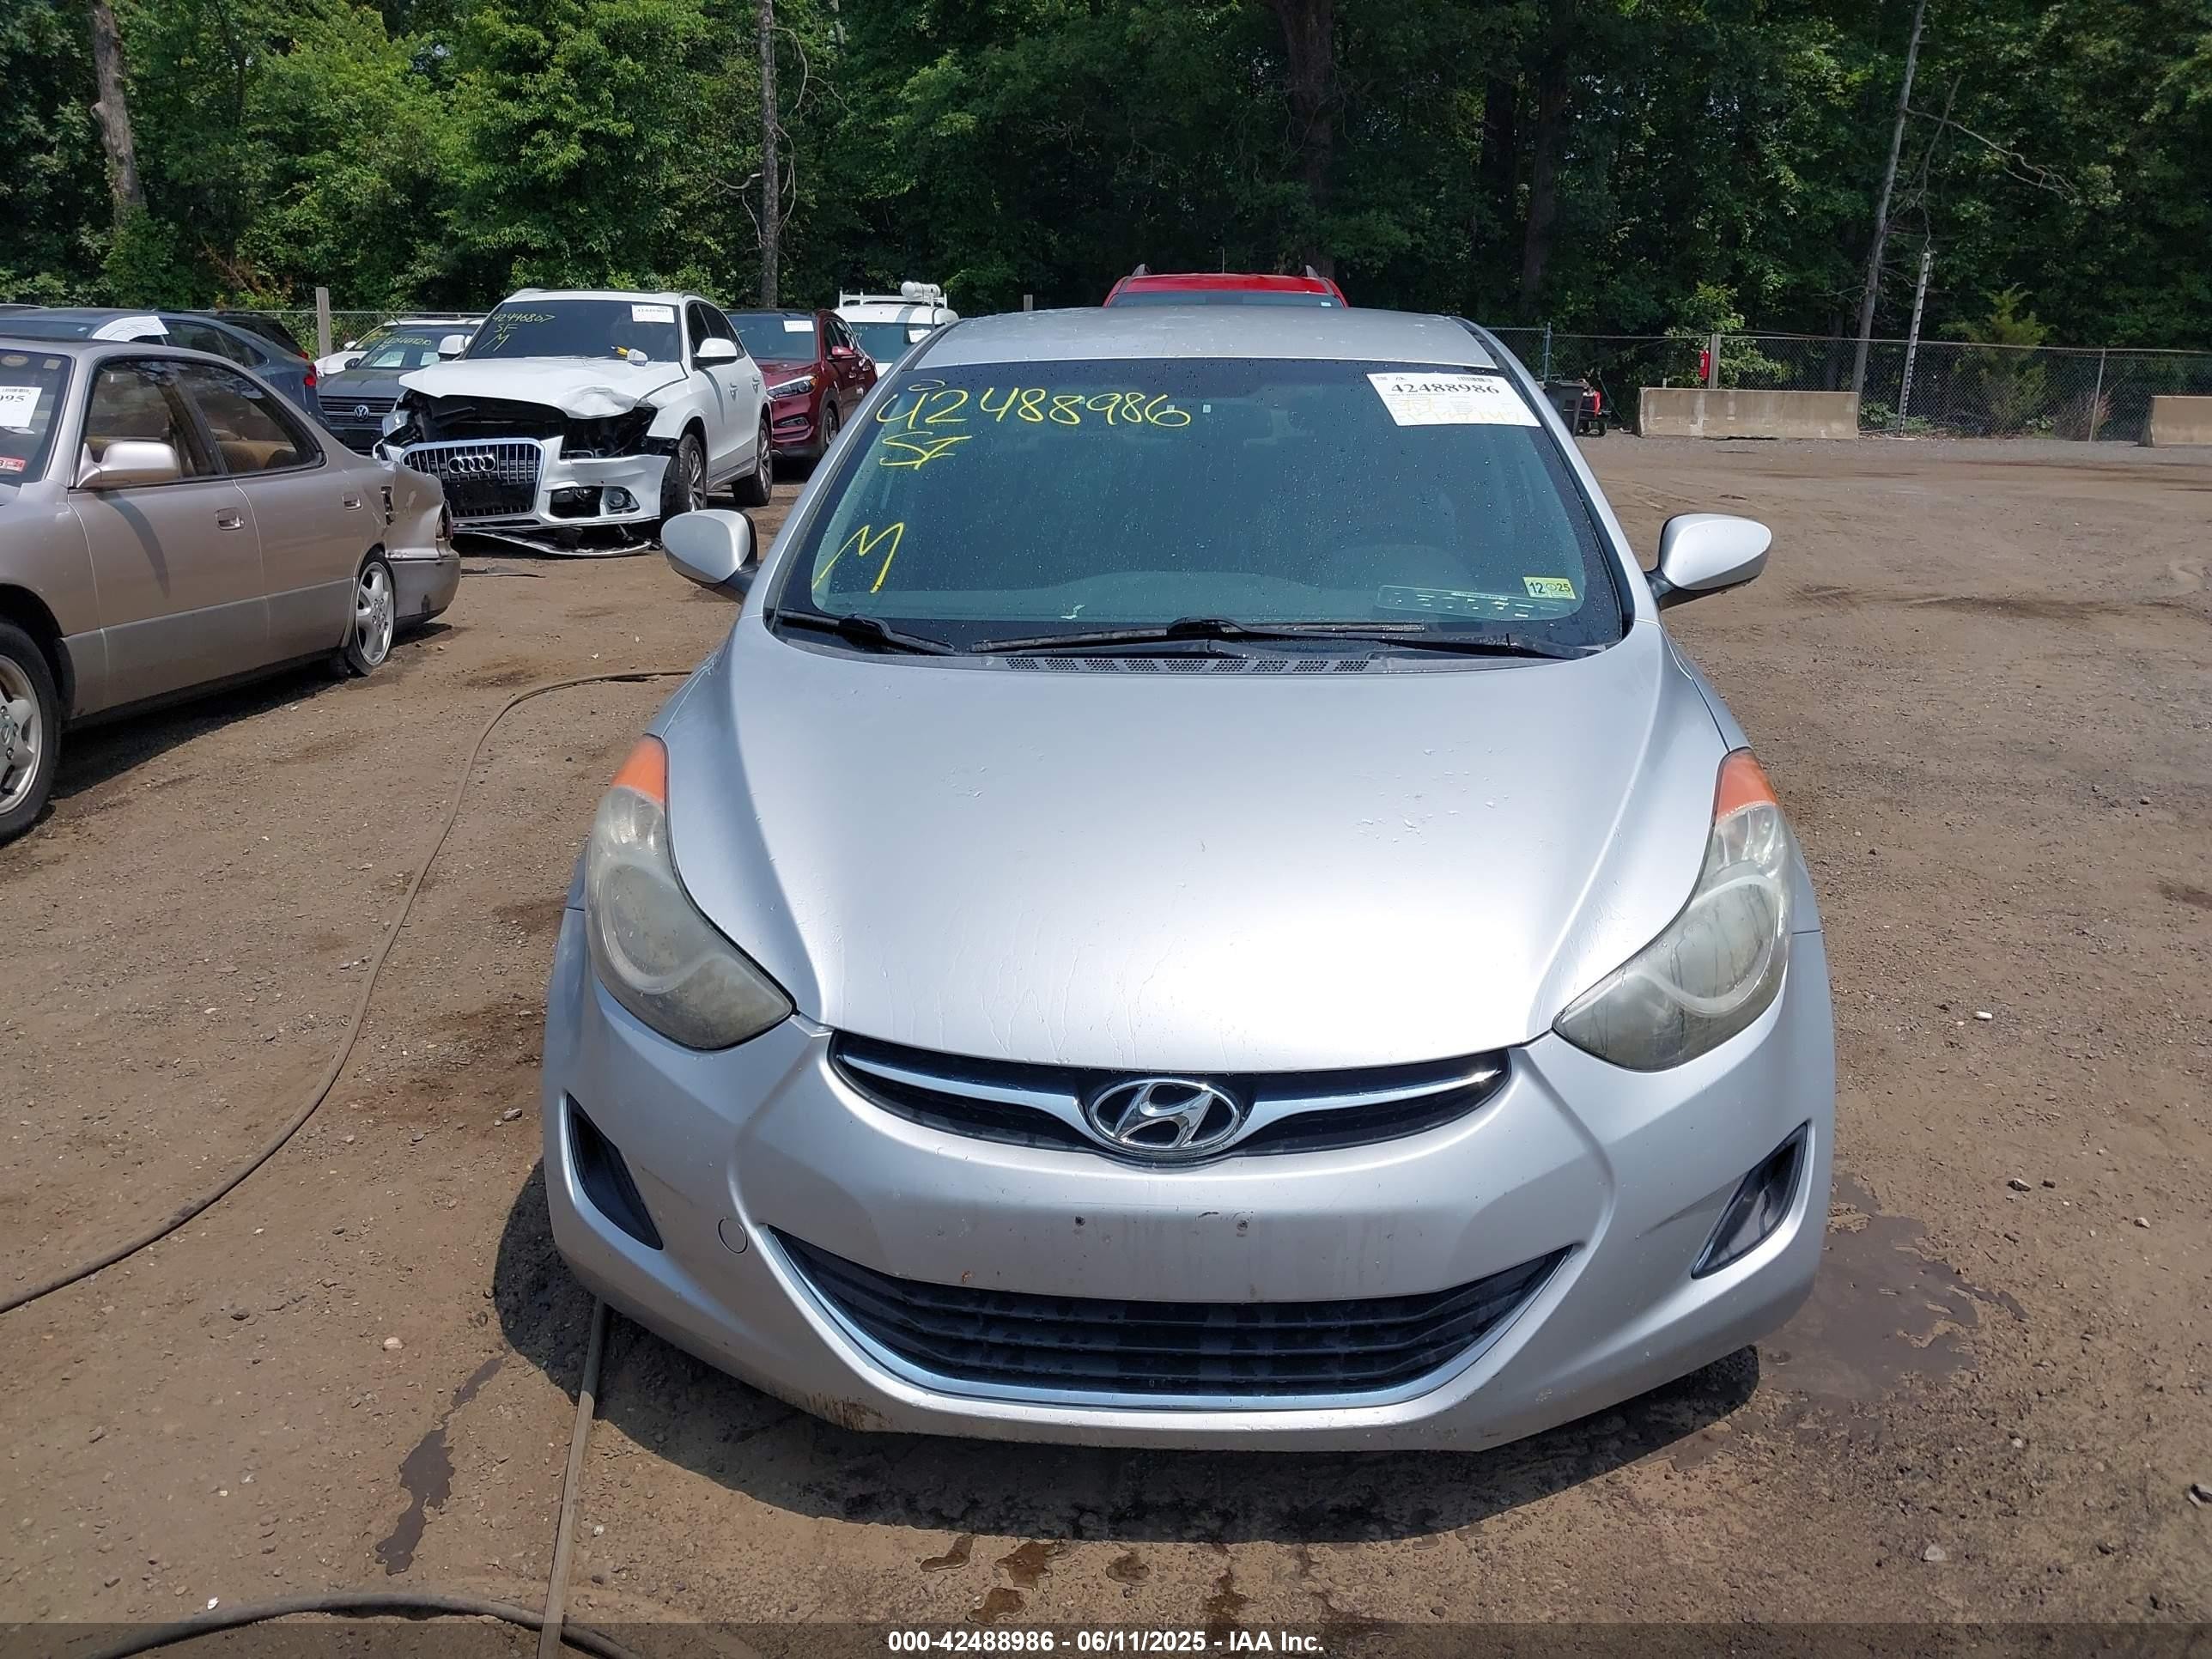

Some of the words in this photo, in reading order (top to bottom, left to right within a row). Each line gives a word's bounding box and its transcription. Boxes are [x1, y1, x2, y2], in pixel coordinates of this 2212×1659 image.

[493, 323, 519, 333] SF
[1391, 383, 1500, 395] 42488986
[875, 385, 1192, 429] 42488986
[811, 522, 904, 594] M
[1529, 581, 1546, 594] 12
[1557, 582, 1571, 592] 25
